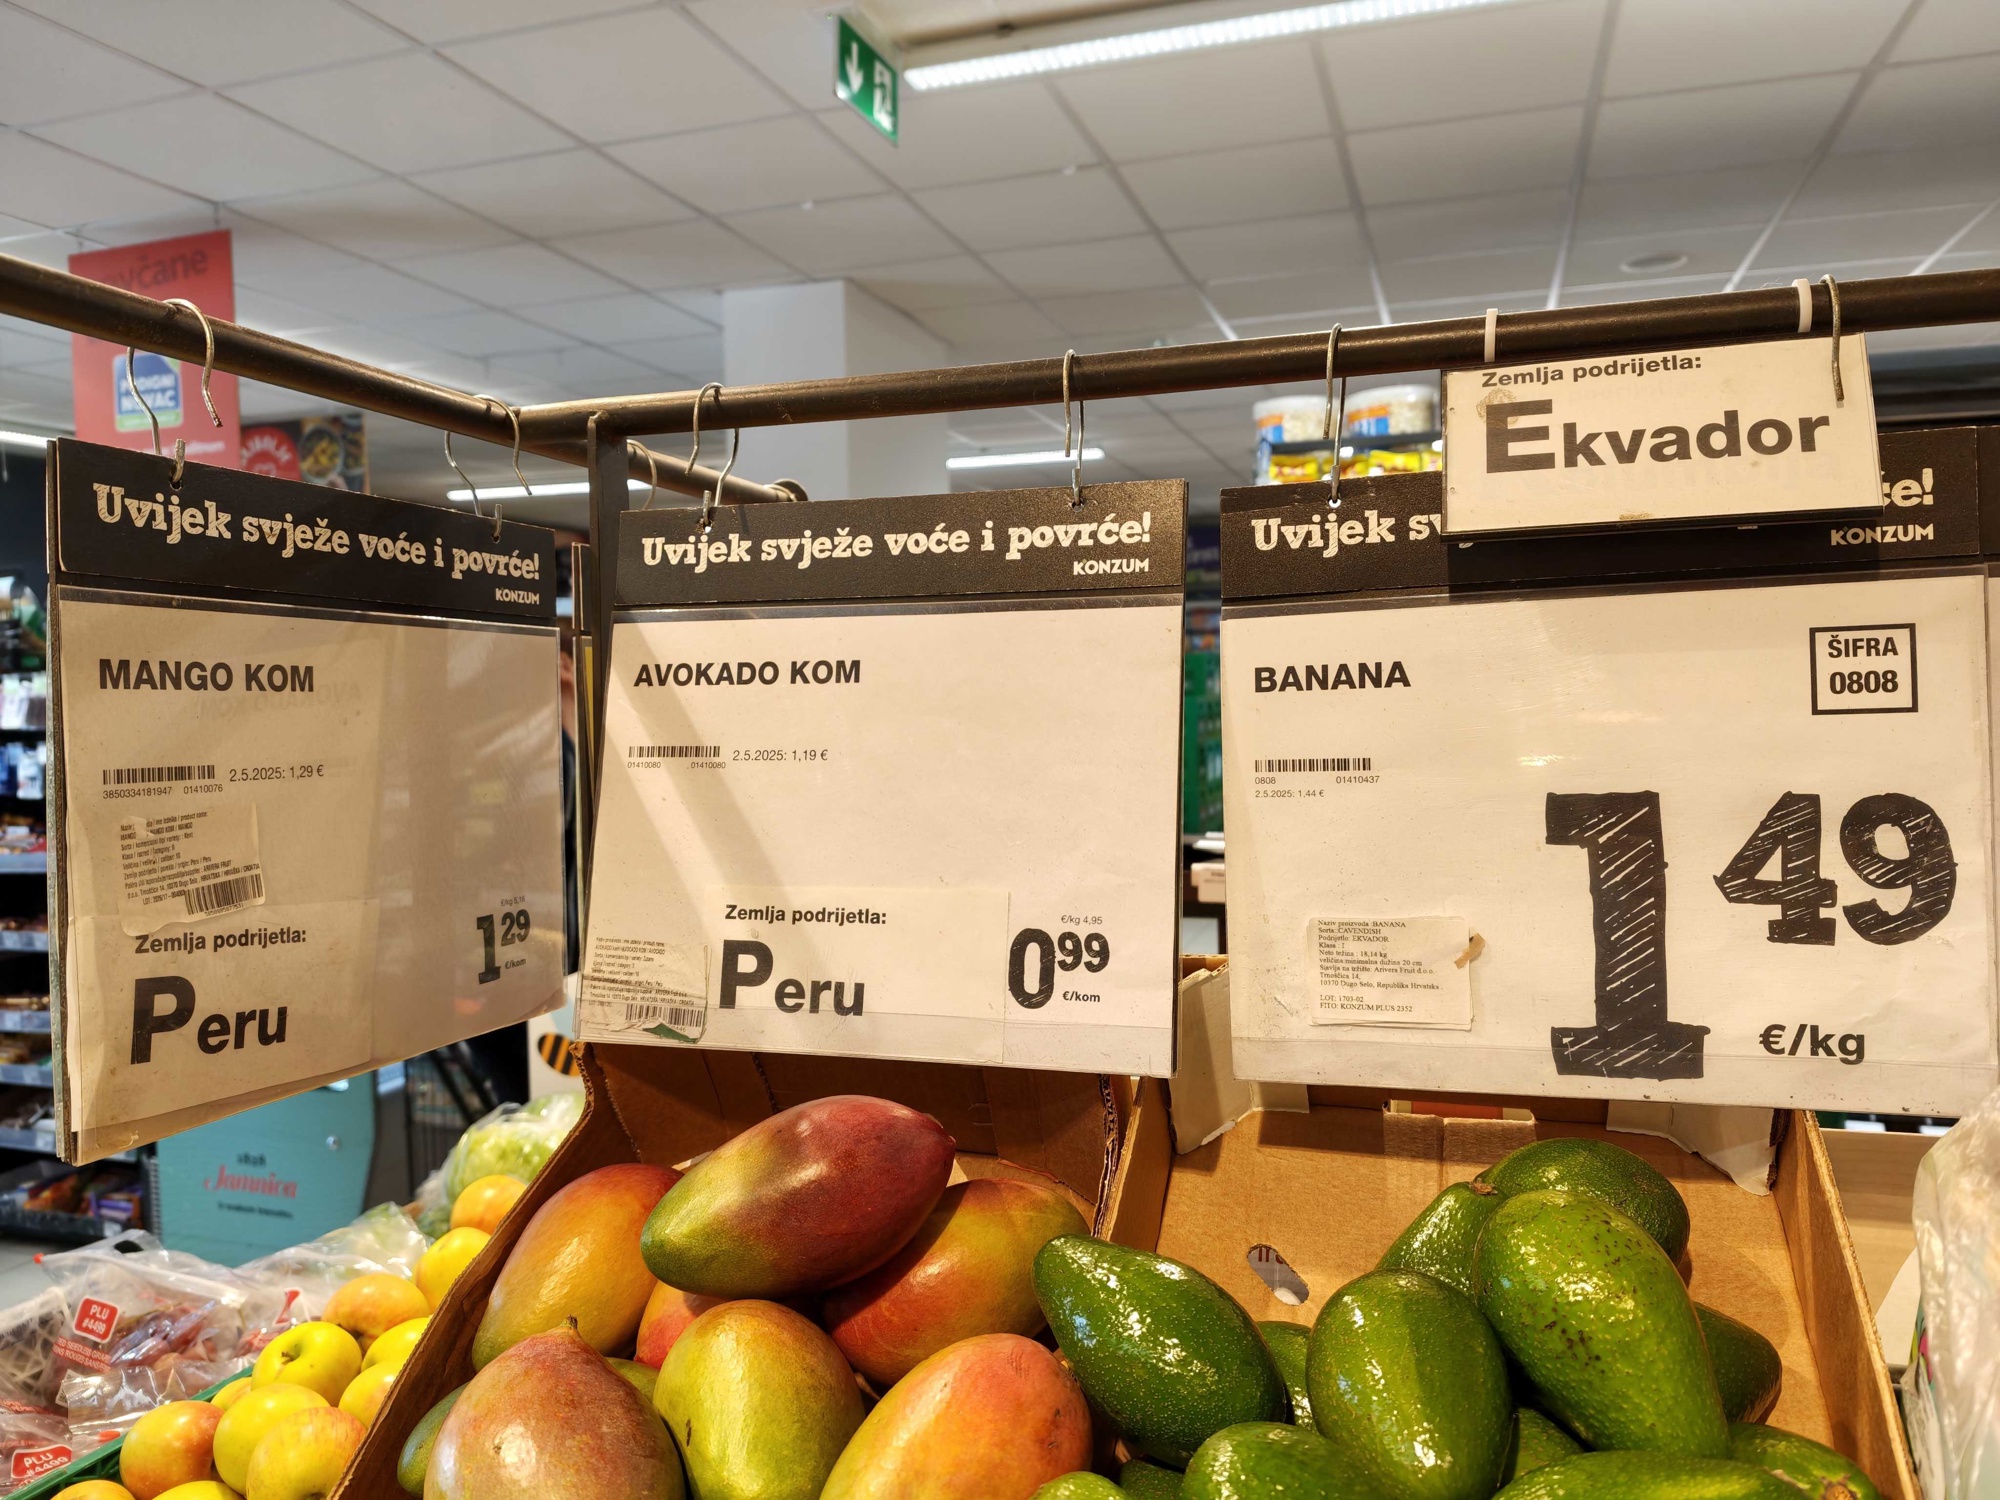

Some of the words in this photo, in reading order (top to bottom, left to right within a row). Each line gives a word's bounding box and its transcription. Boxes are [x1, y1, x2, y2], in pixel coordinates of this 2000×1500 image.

[1481, 365, 1565, 388] Zemlja
[1572, 354, 1701, 382] podrijetla:
[1485, 398, 1830, 474] Ekvador
[93, 483, 232, 544] Uvijek
[242, 514, 350, 558] svježe
[358, 532, 426, 565] voće
[434, 537, 444, 568] i
[451, 550, 540, 580] povrće!
[641, 533, 751, 573] Uvijek
[761, 527, 873, 570] svježe
[884, 522, 970, 557] voće
[980, 520, 995, 552] i
[1005, 511, 1151, 561] povrće!
[1250, 509, 1395, 557] Uvijek
[1830, 522, 1935, 546] KONZUM
[1073, 558, 1150, 576] KONZUM
[495, 588, 540, 605] KONZUM
[1827, 634, 1899, 659] ŠIFRA
[99, 658, 233, 692] MANGO
[245, 663, 314, 692] KOM
[633, 661, 780, 687] AVOKADO
[790, 659, 861, 685] KOM
[1254, 661, 1412, 693] BANANA
[1829, 671, 1899, 695] 0808
[627, 761, 662, 769] 01410080
[690, 761, 726, 769] 01410080
[732, 750, 787, 761] 2.5.2025:
[792, 749, 817, 762] 1,19
[820, 749, 829, 760] €
[229, 767, 286, 782] 2.5.2025:
[289, 765, 314, 780] 1,29
[317, 764, 324, 778] €
[1254, 776, 1277, 785] 0808
[1335, 775, 1380, 784] 01410437
[102, 786, 172, 799] 3850334181947
[183, 784, 223, 795] 01410076
[1255, 790, 1295, 798] 2.5.2025:
[1298, 789, 1317, 798] 1,44
[1318, 789, 1325, 797] €
[725, 904, 786, 924] Zemlja
[791, 907, 887, 926] podrijetla:
[1060, 915, 1081, 926] €/kg
[1082, 916, 1103, 925] 4,95
[135, 935, 206, 954] Zemlja
[213, 926, 306, 953] podrijetla:
[476, 914, 501, 985] 1
[500, 909, 531, 946] 29
[1545, 790, 1711, 1081] 1
[1713, 790, 1958, 946] 49
[719, 939, 865, 1016] Peru
[1008, 927, 1056, 1009] 0
[1057, 931, 1110, 973] 99
[1062, 991, 1101, 1003] €/kom
[130, 975, 288, 1065] Peru
[1759, 1023, 1866, 1065] €/kg
[89, 1304, 110, 1320] PLU
[23, 1452, 53, 1468] PLU
